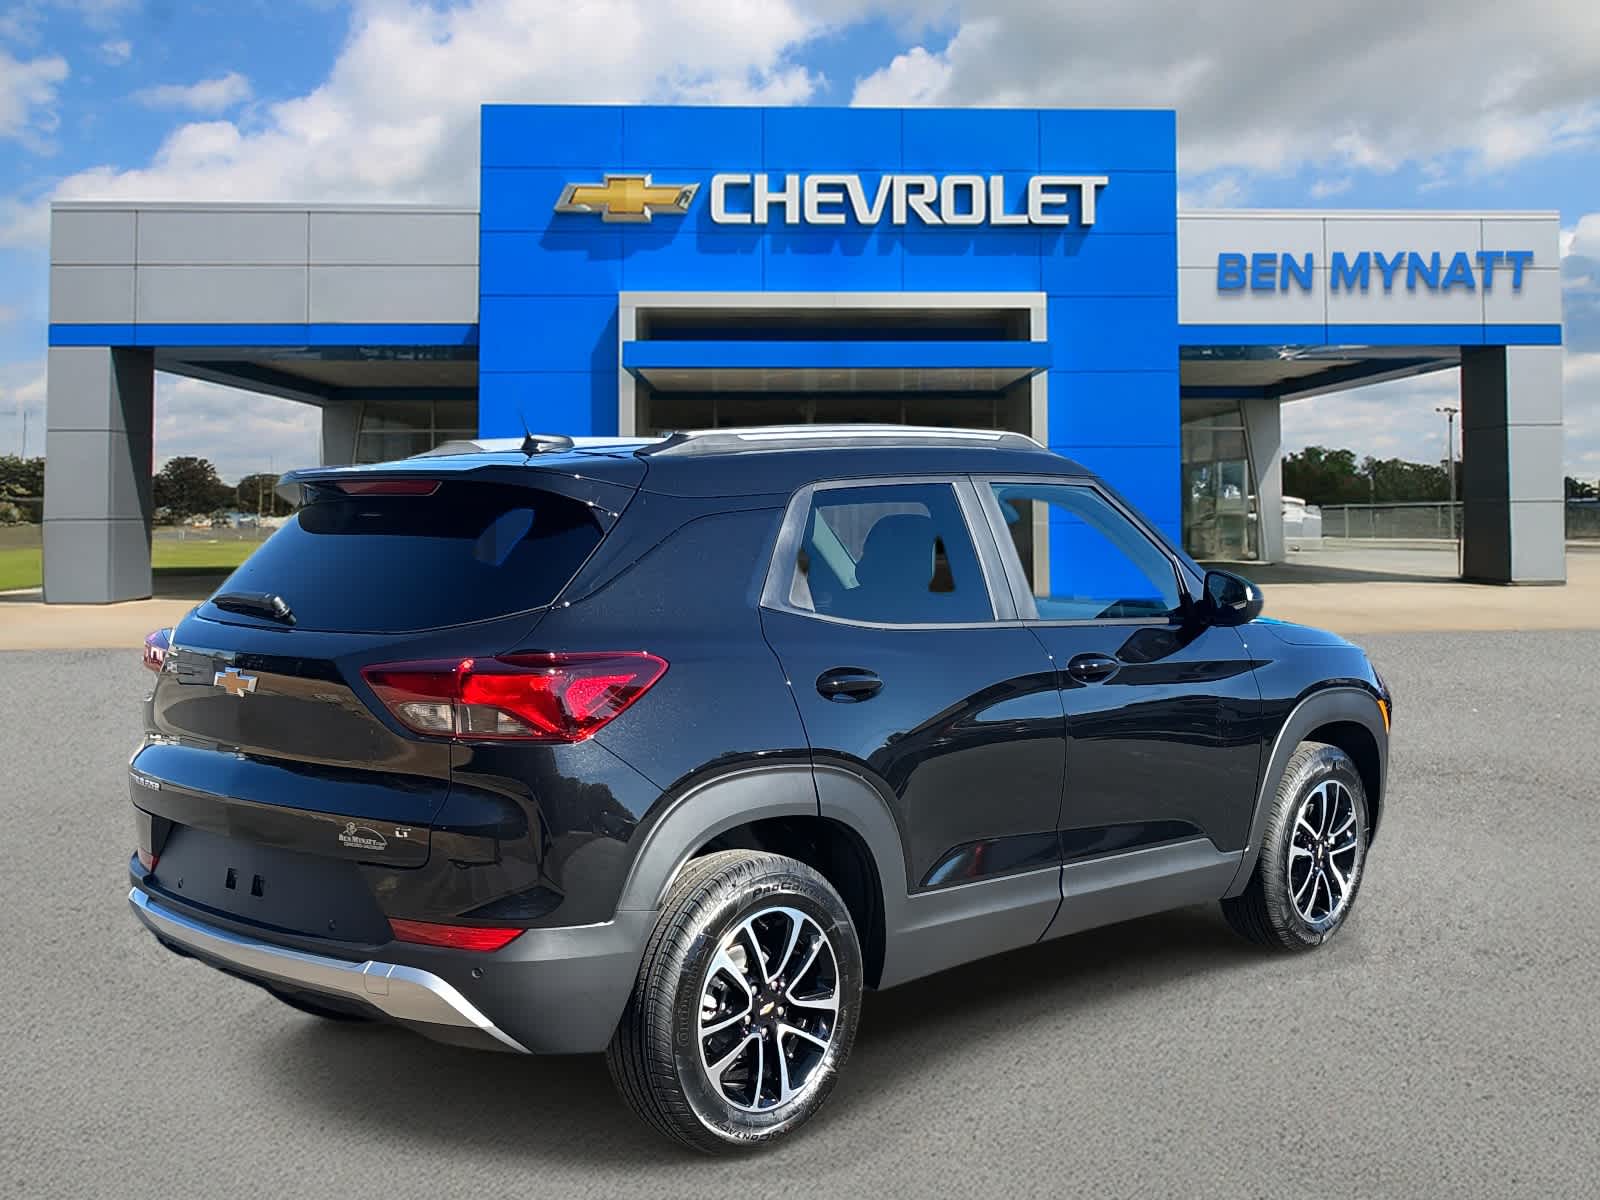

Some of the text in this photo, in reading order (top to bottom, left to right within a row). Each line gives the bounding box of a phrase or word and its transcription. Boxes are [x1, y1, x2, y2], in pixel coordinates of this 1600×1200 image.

[710, 173, 1109, 226] CHEVROLET
[1217, 250, 1534, 291] BEN MYNATT
